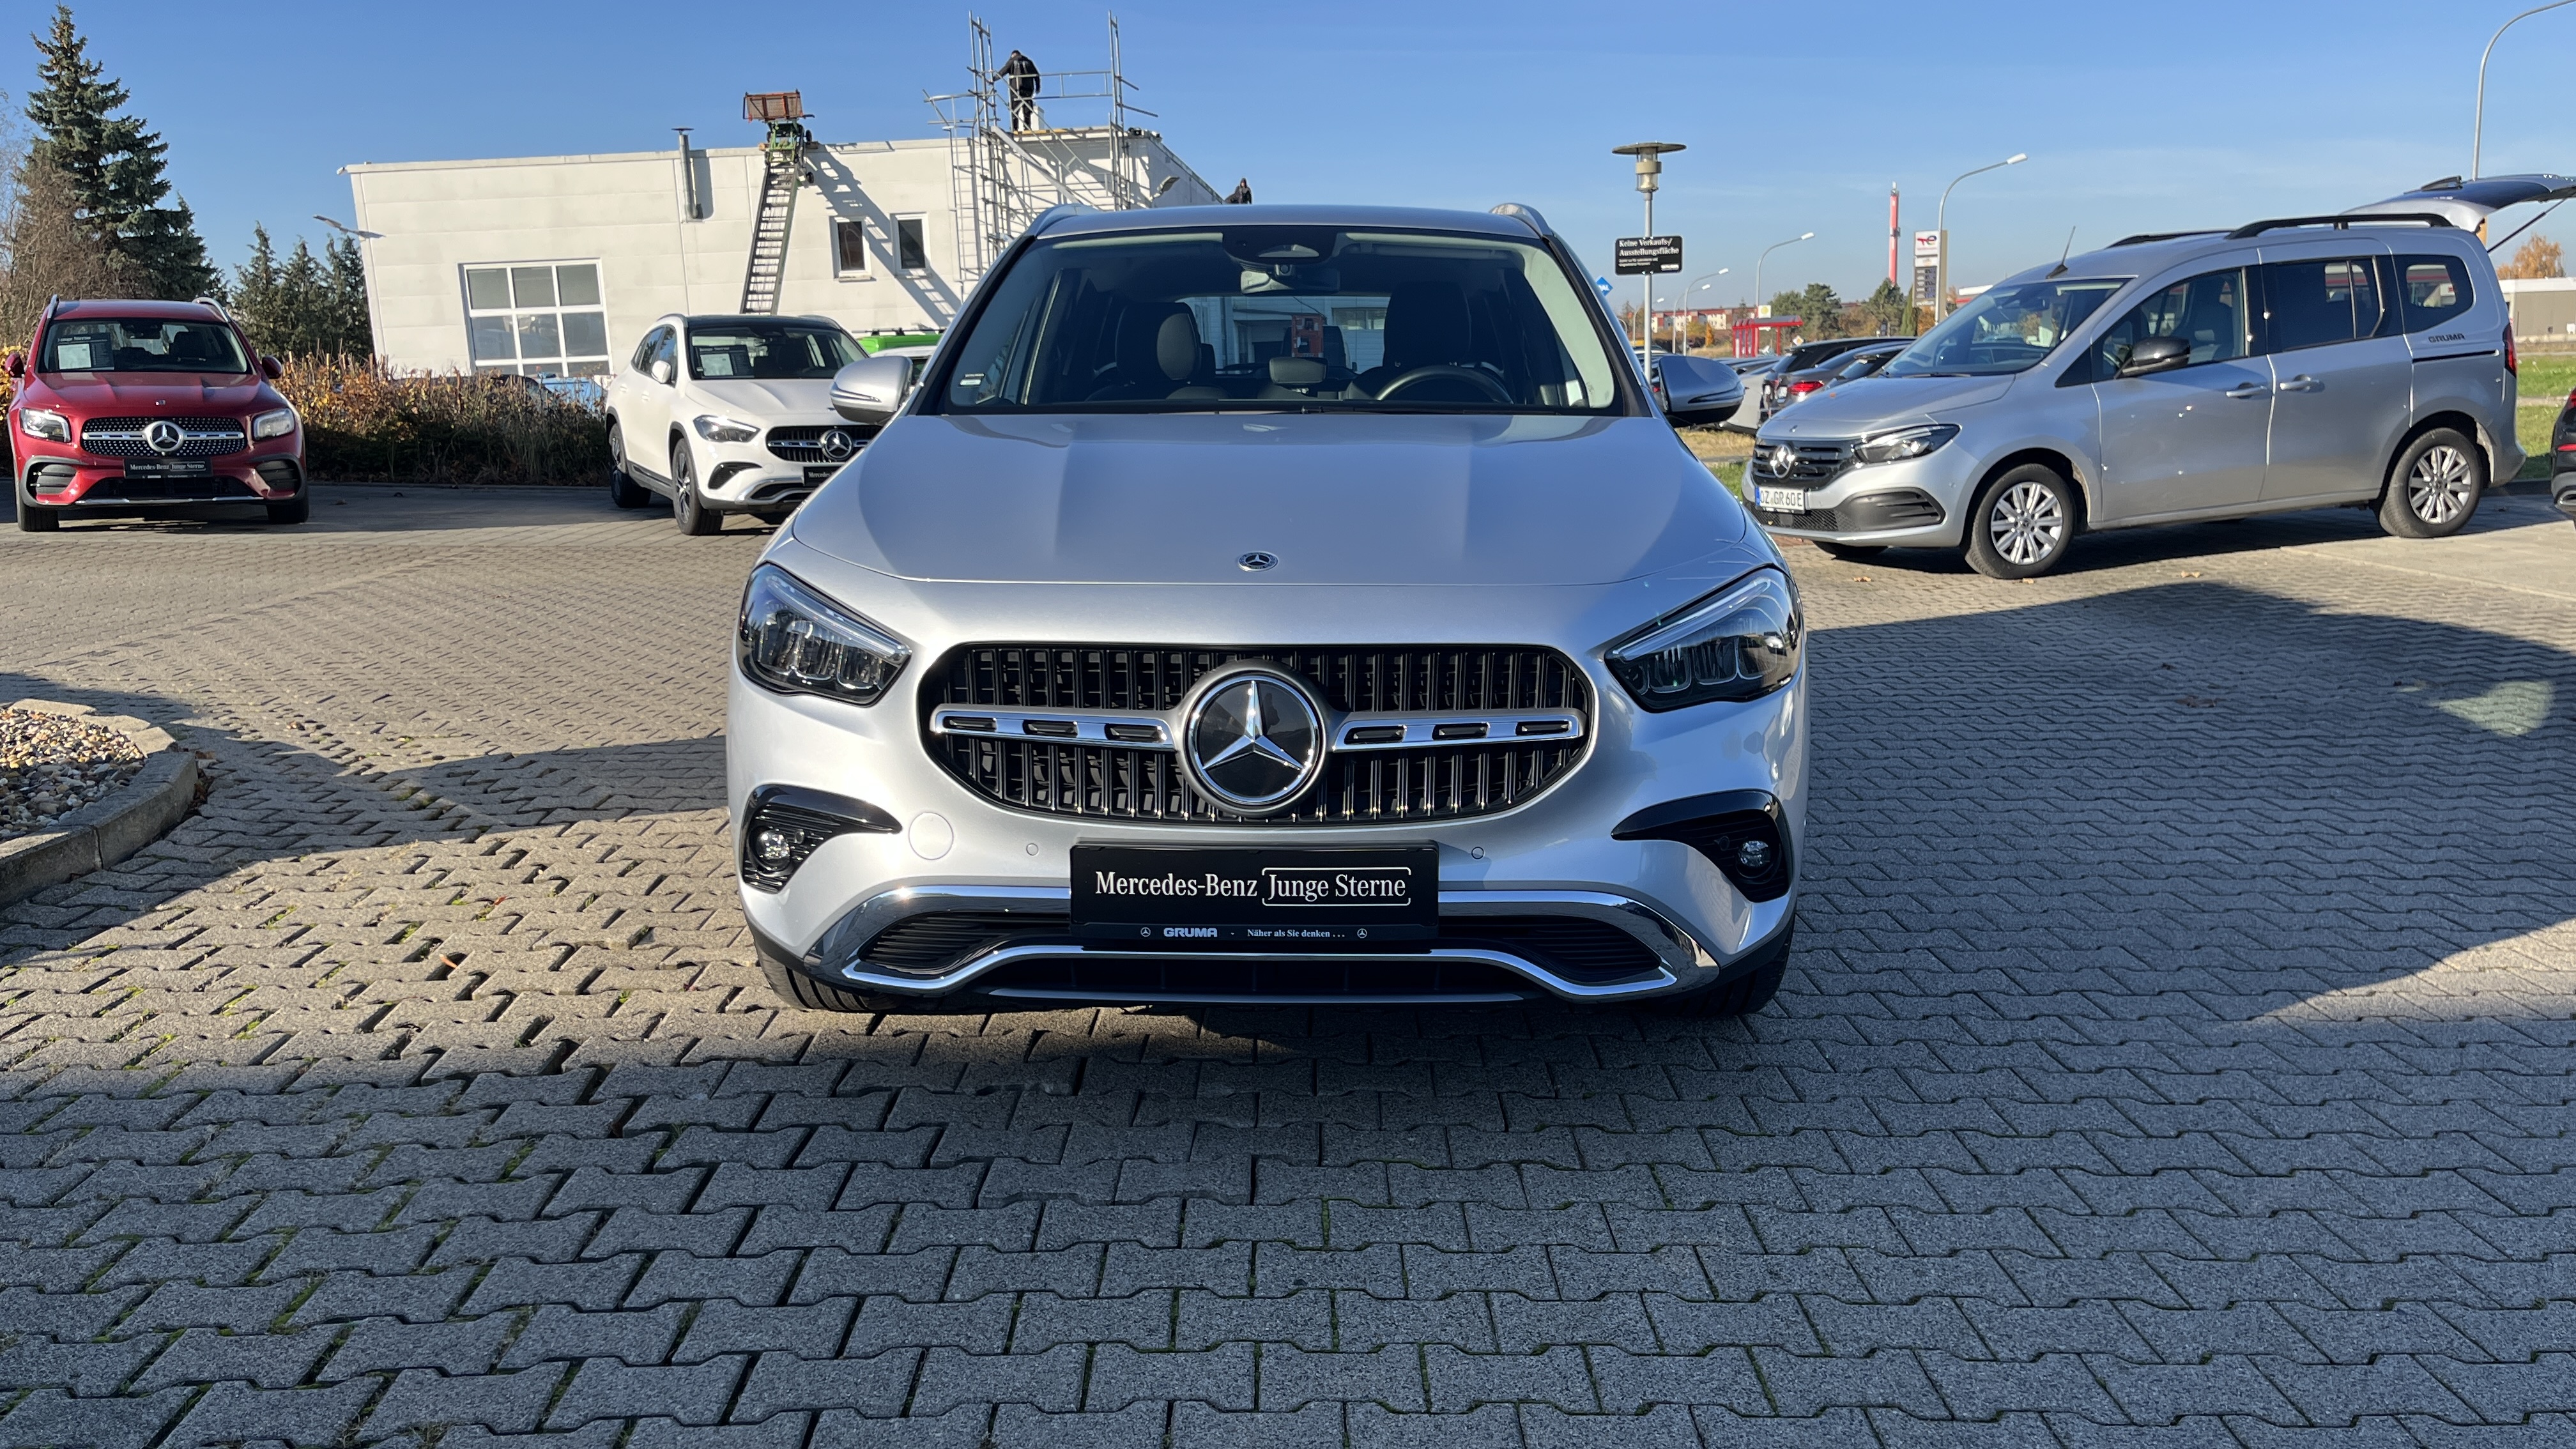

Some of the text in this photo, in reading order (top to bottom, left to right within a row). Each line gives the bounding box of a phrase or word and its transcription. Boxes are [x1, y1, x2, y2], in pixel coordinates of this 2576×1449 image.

[2428, 333, 2465, 342] GRUMA
[1760, 490, 1770, 504] OZ
[1095, 871, 1406, 901] Mercedes-Benz Junge Sterne
[1163, 928, 1218, 937] GRUMA
[1287, 929, 1300, 937] Sie
